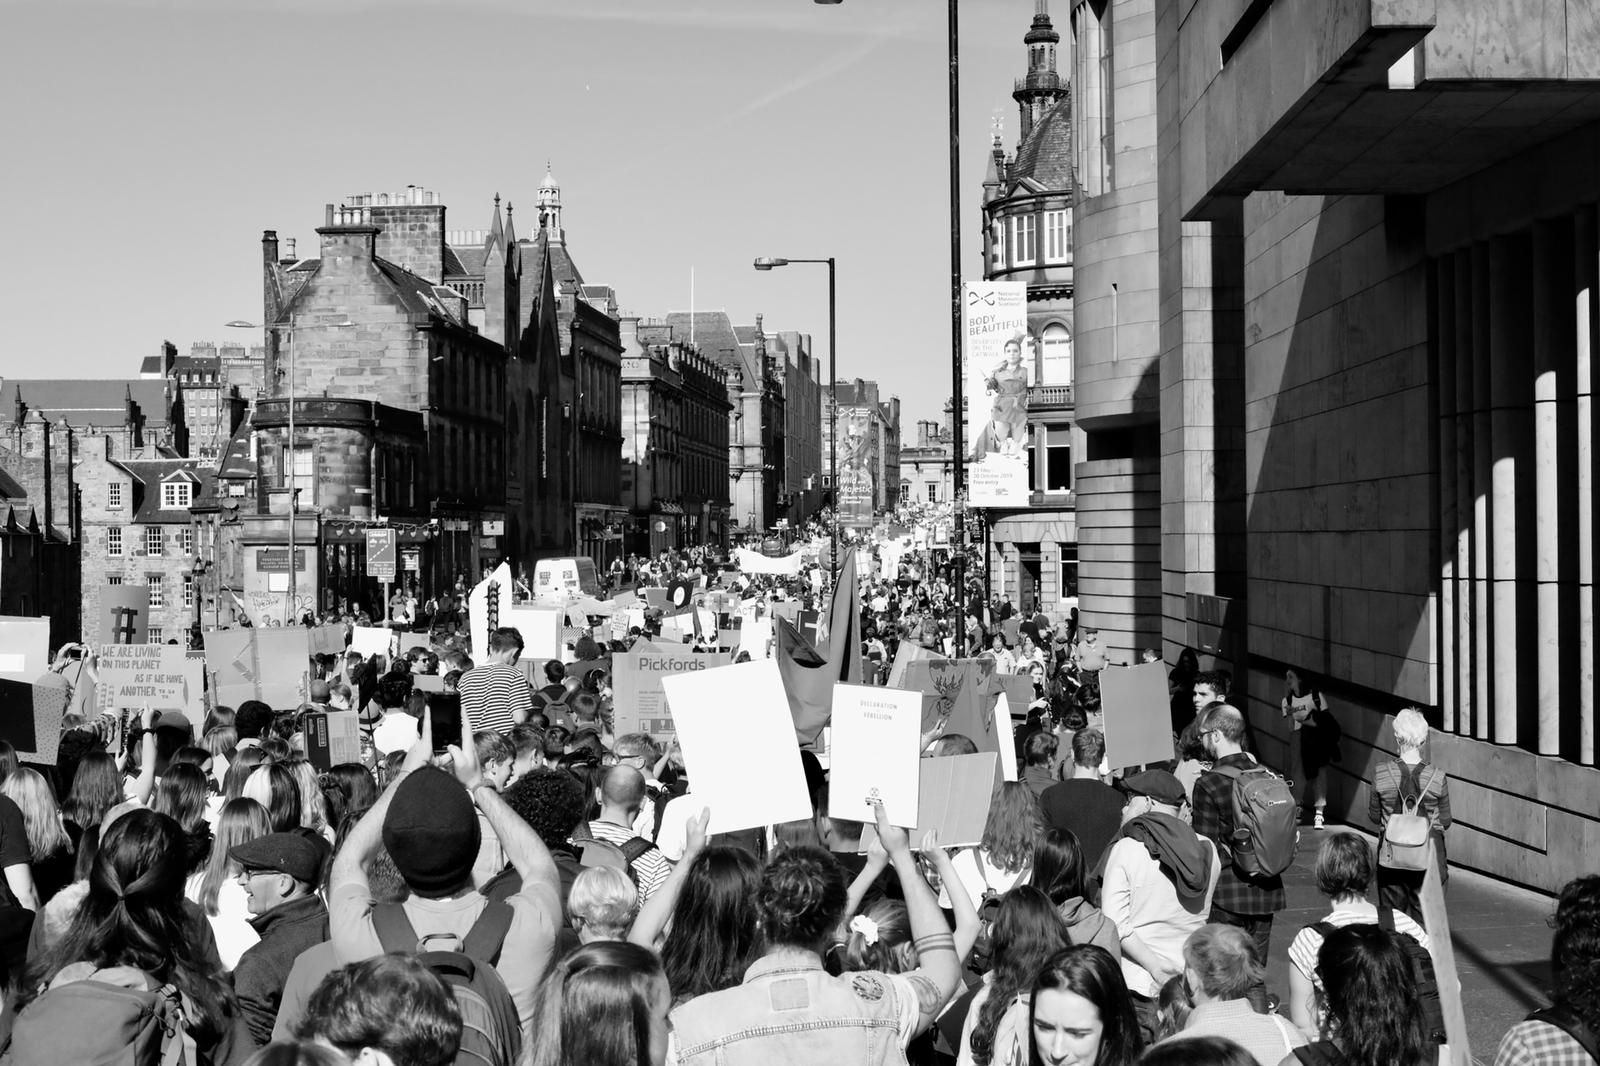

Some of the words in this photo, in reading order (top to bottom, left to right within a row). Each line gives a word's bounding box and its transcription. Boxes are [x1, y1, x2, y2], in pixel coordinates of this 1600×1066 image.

[969, 314, 996, 326] BODY
[969, 319, 1024, 336] BEAUTIFUL
[839, 476, 857, 484] Wild
[839, 485, 872, 495] Majestic
[736, 607, 754, 616] ACT
[102, 646, 115, 657] WE
[117, 646, 133, 658] ARE
[134, 647, 162, 658] LIVING
[102, 659, 113, 669] ON
[114, 660, 130, 669] THIS
[132, 660, 161, 670] PLANET
[639, 657, 706, 671] Pickfords
[134, 674, 144, 683] AS
[145, 674, 153, 683] IF
[154, 674, 165, 683] WE
[166, 674, 184, 684] HAVE
[120, 686, 156, 696] ANOTHER
[860, 699, 897, 710] DECLARATION
[863, 711, 892, 721] REBELLION
